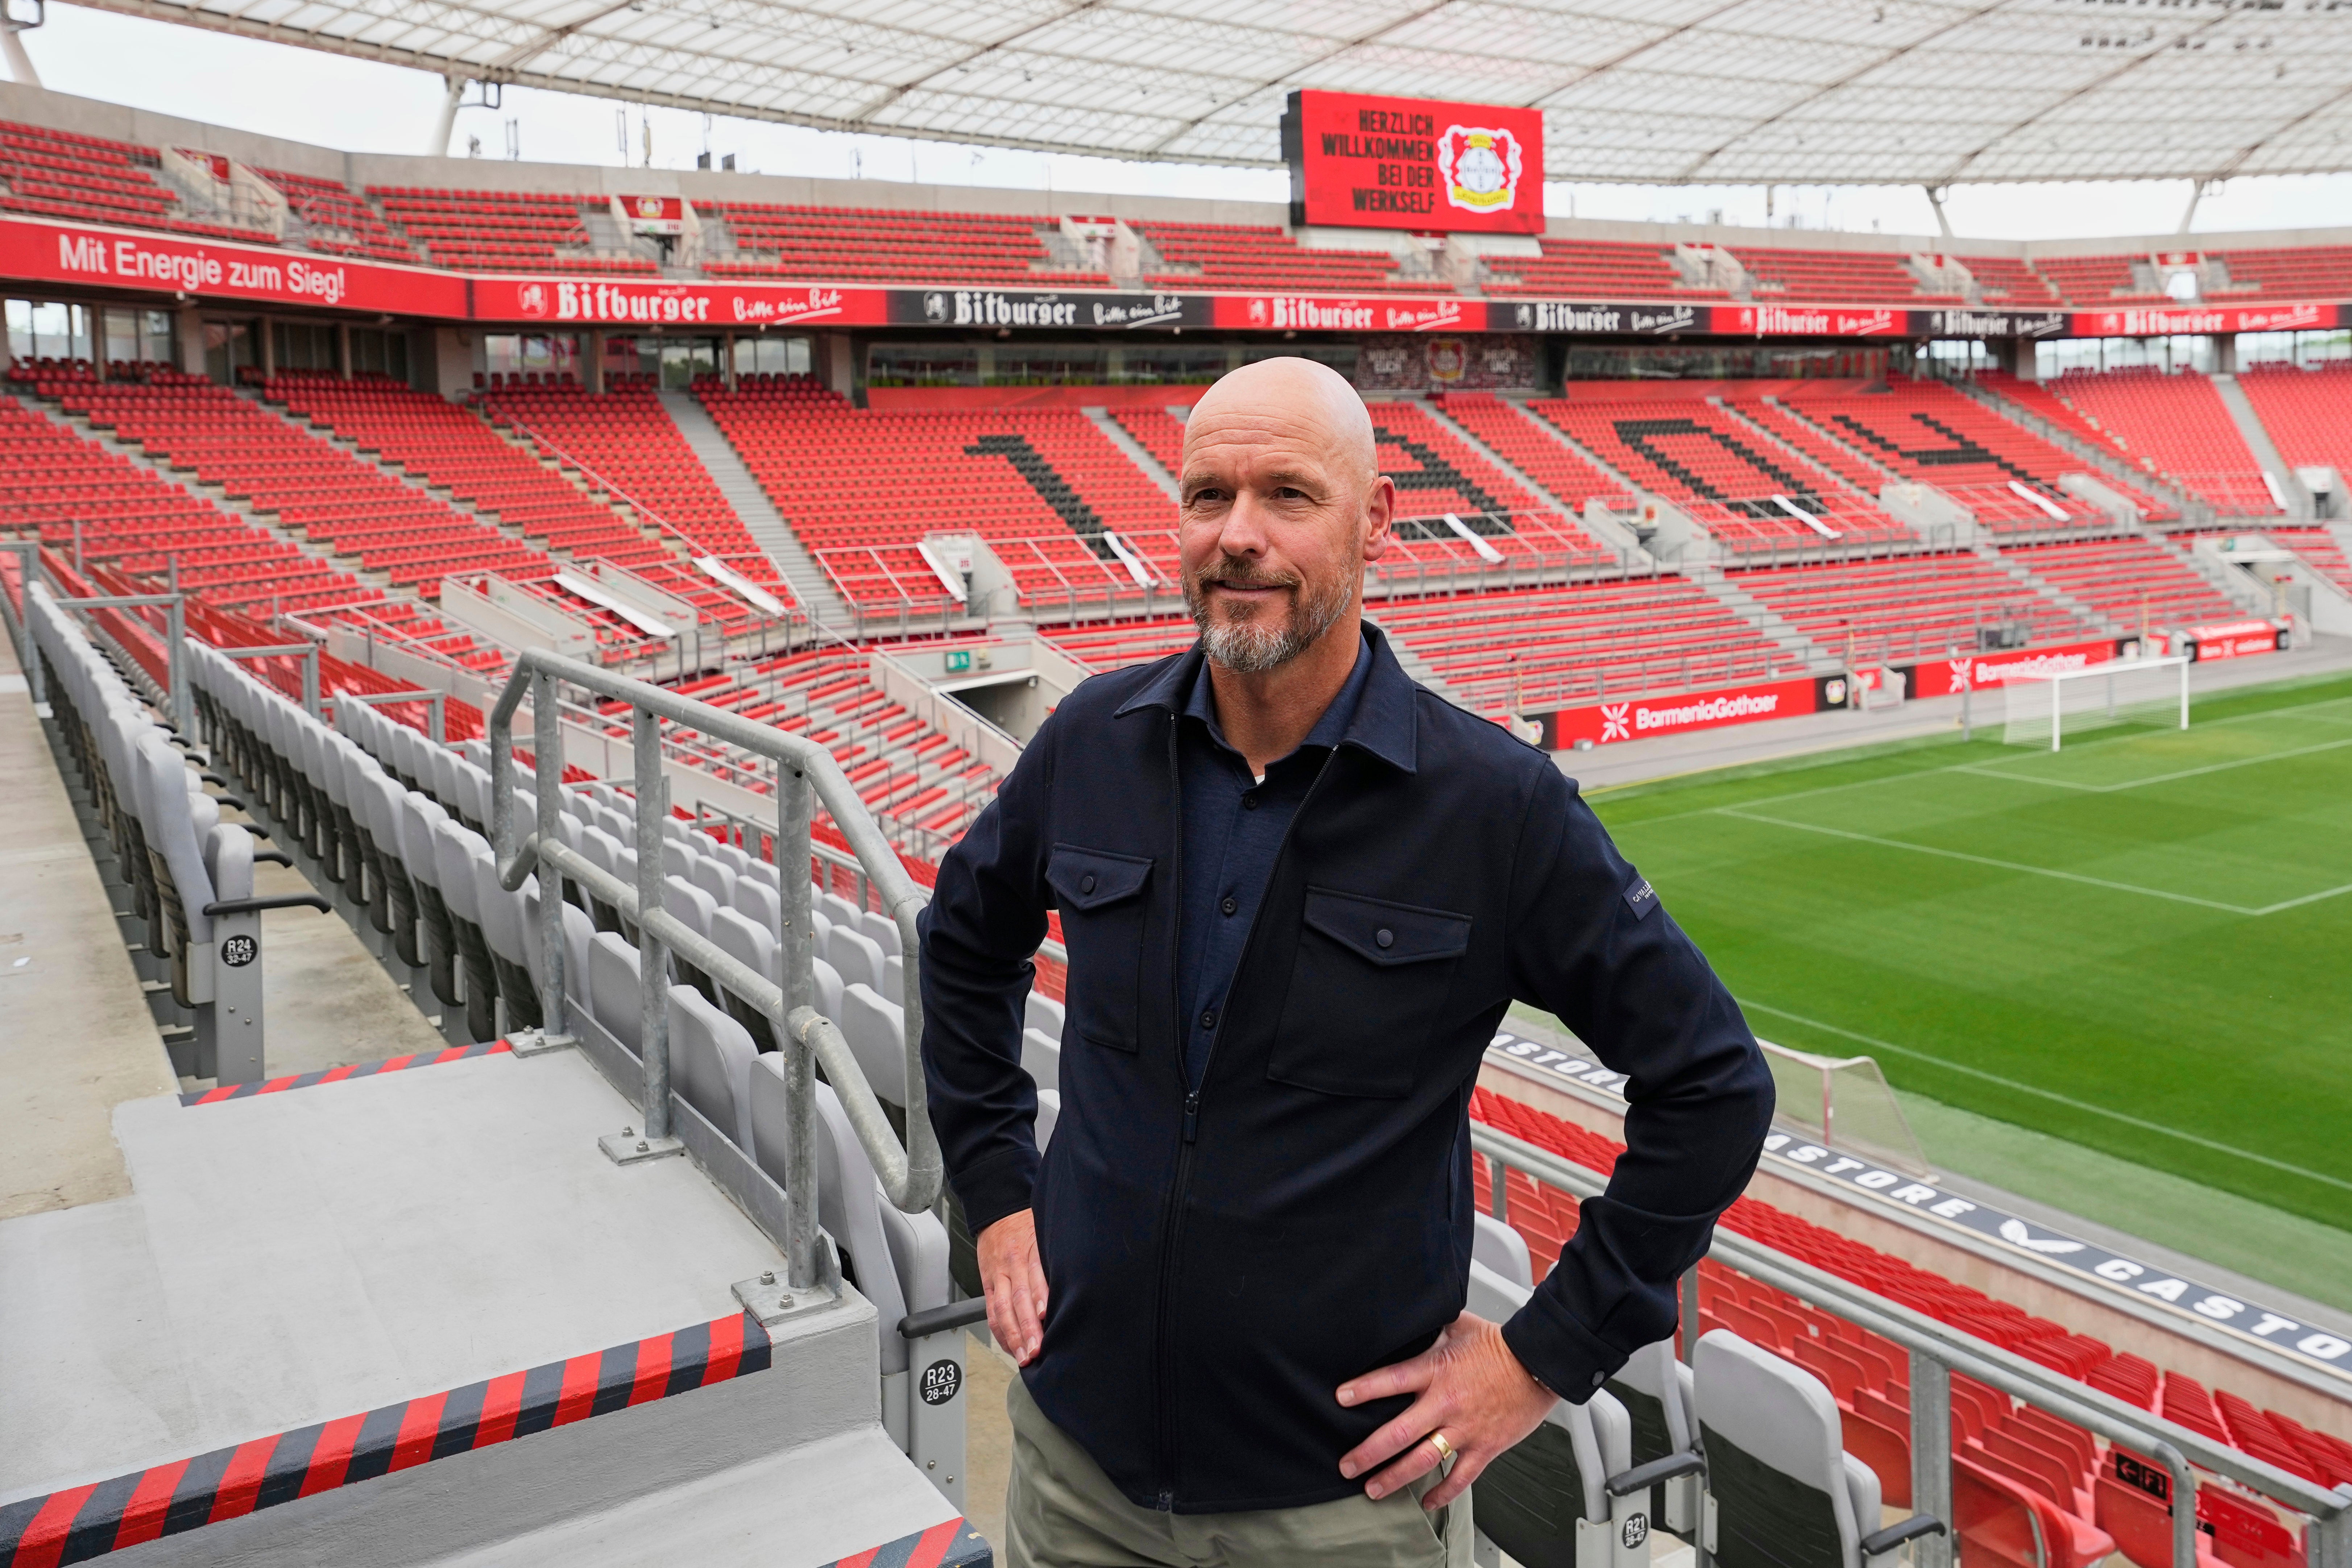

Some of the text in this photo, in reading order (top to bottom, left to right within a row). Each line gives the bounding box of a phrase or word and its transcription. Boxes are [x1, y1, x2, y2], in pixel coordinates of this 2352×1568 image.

[1359, 109, 1433, 136] HERZLICH
[1321, 132, 1434, 162] WILLKOMMEN
[1378, 163, 1434, 188] BEI DER
[1352, 188, 1435, 213] WERKSELF
[59, 234, 345, 304] Mit Energie zum Sieg!
[557, 282, 843, 322] Bitburger Bitte ein Bit
[954, 291, 1076, 325] Bitburger
[1093, 303, 1127, 325] Bitte
[1130, 303, 1155, 318] ein
[1155, 294, 1183, 314] Bit
[1272, 297, 1374, 328] Bitburger
[1535, 303, 1620, 331] Bitburger
[2124, 310, 2224, 334] Bitburger
[1636, 694, 1779, 730] BarmeniaGothaer
[227, 939, 251, 953] R24
[227, 953, 252, 965] 32-47
[2094, 1258, 2352, 1359] CASTO
[927, 1364, 955, 1386] R23
[926, 1384, 955, 1401] 28-47
[1626, 1515, 1645, 1534] R21
